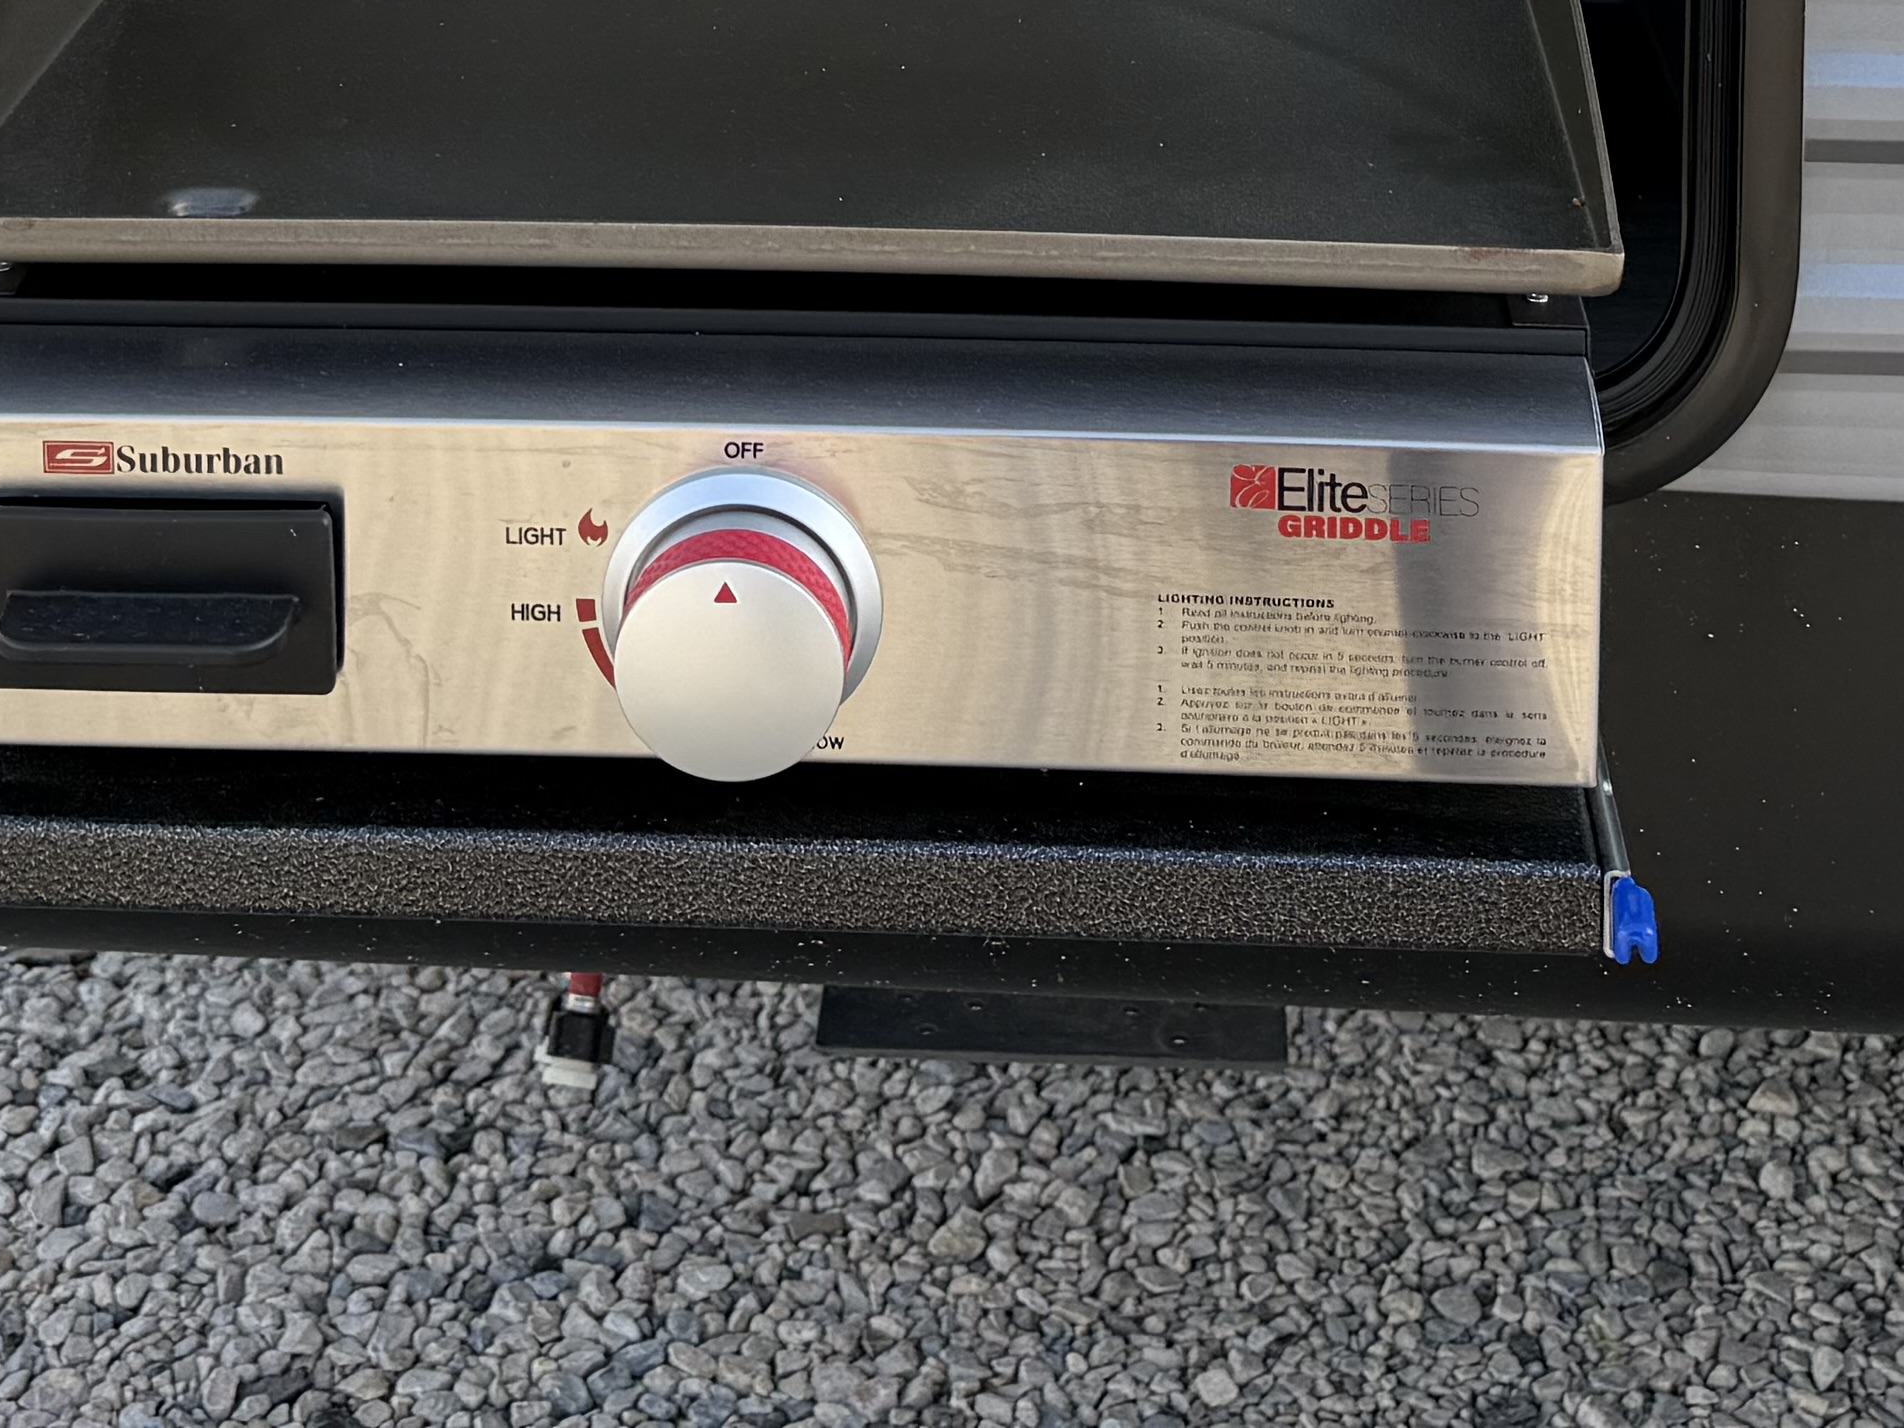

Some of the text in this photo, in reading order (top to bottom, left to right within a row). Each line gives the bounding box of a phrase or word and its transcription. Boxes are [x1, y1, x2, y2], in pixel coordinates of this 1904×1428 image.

[116, 445, 284, 475] Suburban
[724, 442, 764, 459] OFF
[505, 527, 567, 546] LIGHT
[1277, 515, 1431, 543] GRIDDLE
[511, 603, 561, 622] HIGH
